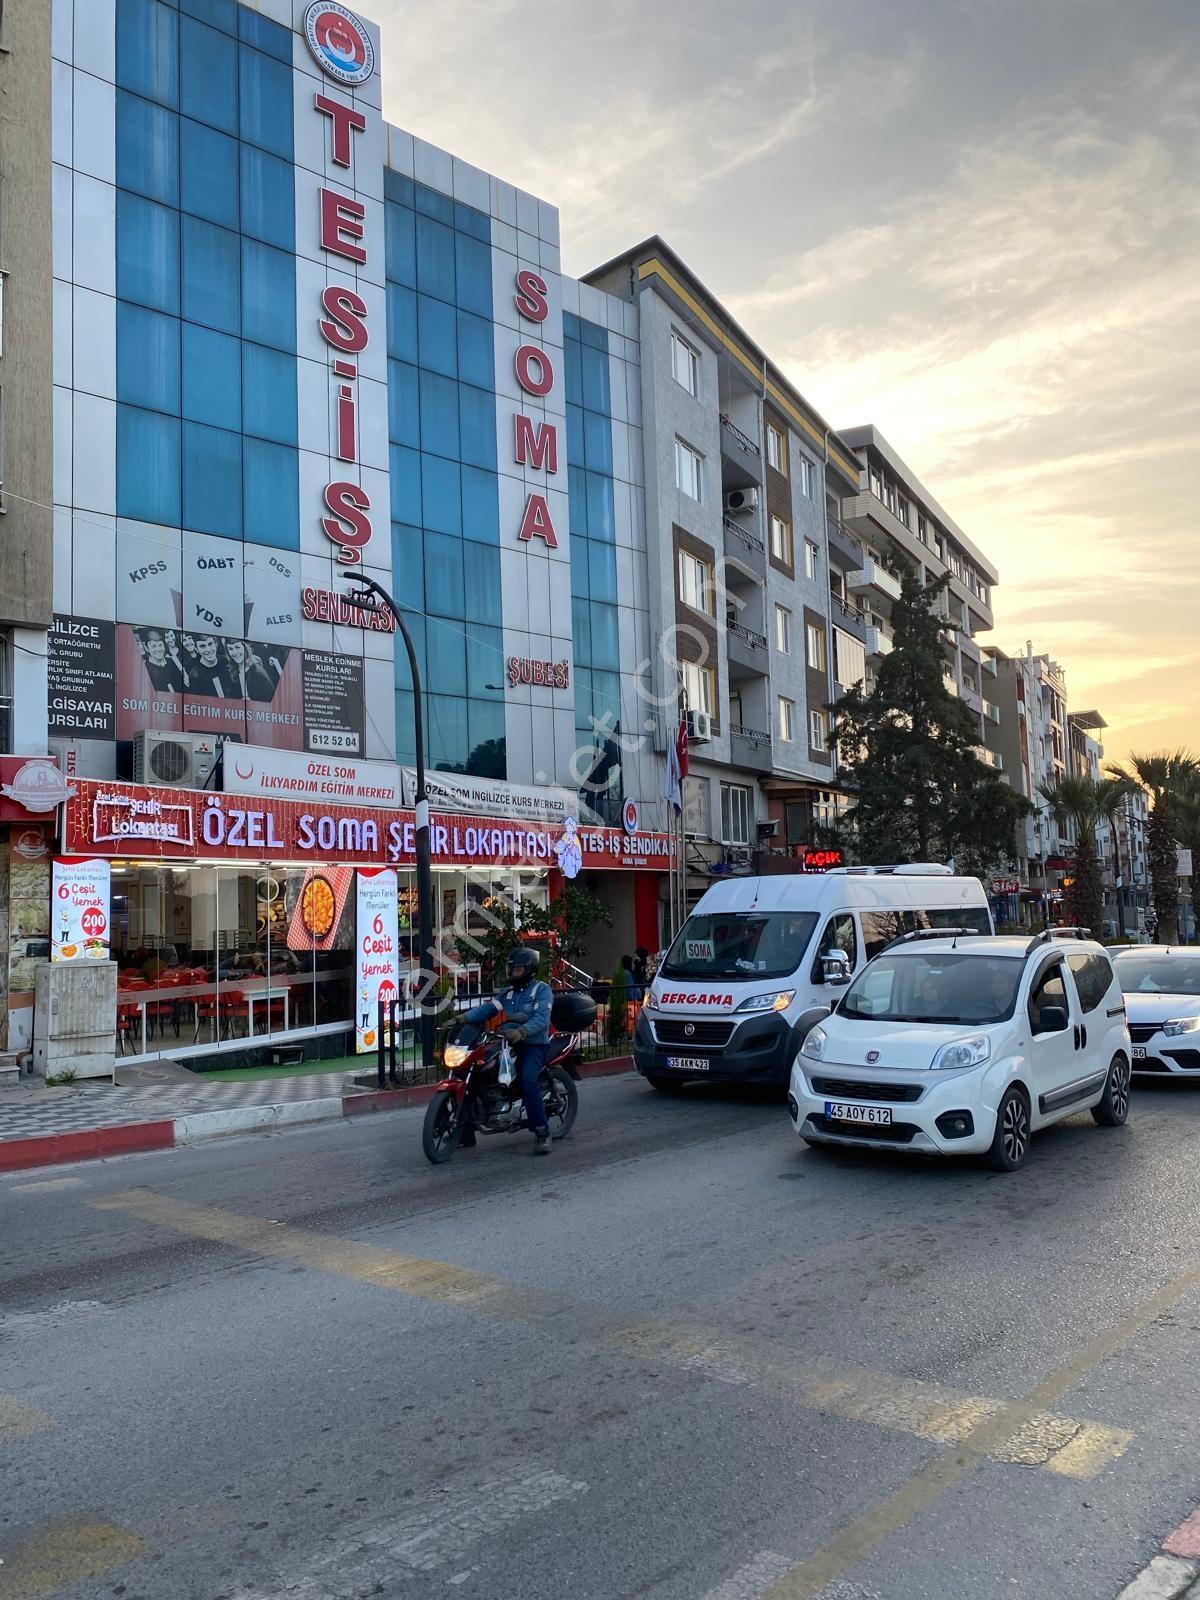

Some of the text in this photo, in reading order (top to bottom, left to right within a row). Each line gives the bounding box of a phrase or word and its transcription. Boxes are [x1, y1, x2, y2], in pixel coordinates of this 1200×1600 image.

[515, 269, 559, 549] SOMA
[128, 560, 168, 583] KPSS
[197, 557, 235, 570] ÖABT
[268, 556, 292, 578] DGS
[194, 604, 223, 628] YDS
[265, 614, 293, 626] ALES
[59, 649, 83, 658] GRUBU
[304, 653, 334, 664] MESLEK
[315, 665, 352, 675] KURSLARI
[122, 698, 149, 711] SOM
[183, 702, 221, 718] EĞİTİM
[224, 708, 253, 721] KURS
[312, 734, 357, 747] 612 52 04
[307, 760, 356, 779] ÖZEL SOM
[260, 772, 395, 800] İLKYARDIM EĞİTİM MERKEZİ
[425, 783, 449, 797] ÖZEL
[451, 787, 470, 799] SOM
[472, 789, 511, 805] İNGİLİZCE
[512, 794, 532, 807] KURS
[533, 798, 565, 811] MERKEZİ
[203, 795, 285, 848] ÖZEL
[297, 814, 378, 852] SOMA
[388, 816, 449, 862] ŞEİR
[580, 830, 621, 858] TES-İŞ
[58, 883, 97, 899] 6 Çeşit
[359, 889, 381, 900] Hergün
[83, 914, 105, 928] 200
[373, 914, 383, 935] 6
[362, 935, 392, 957] Çeşit
[688, 943, 713, 958] SOMA
[661, 993, 733, 1006] BERGAMA
[671, 1058, 680, 1067] 35
[695, 1059, 708, 1069] 423
[831, 1105, 843, 1118] 45
[868, 1109, 890, 1123] 612
